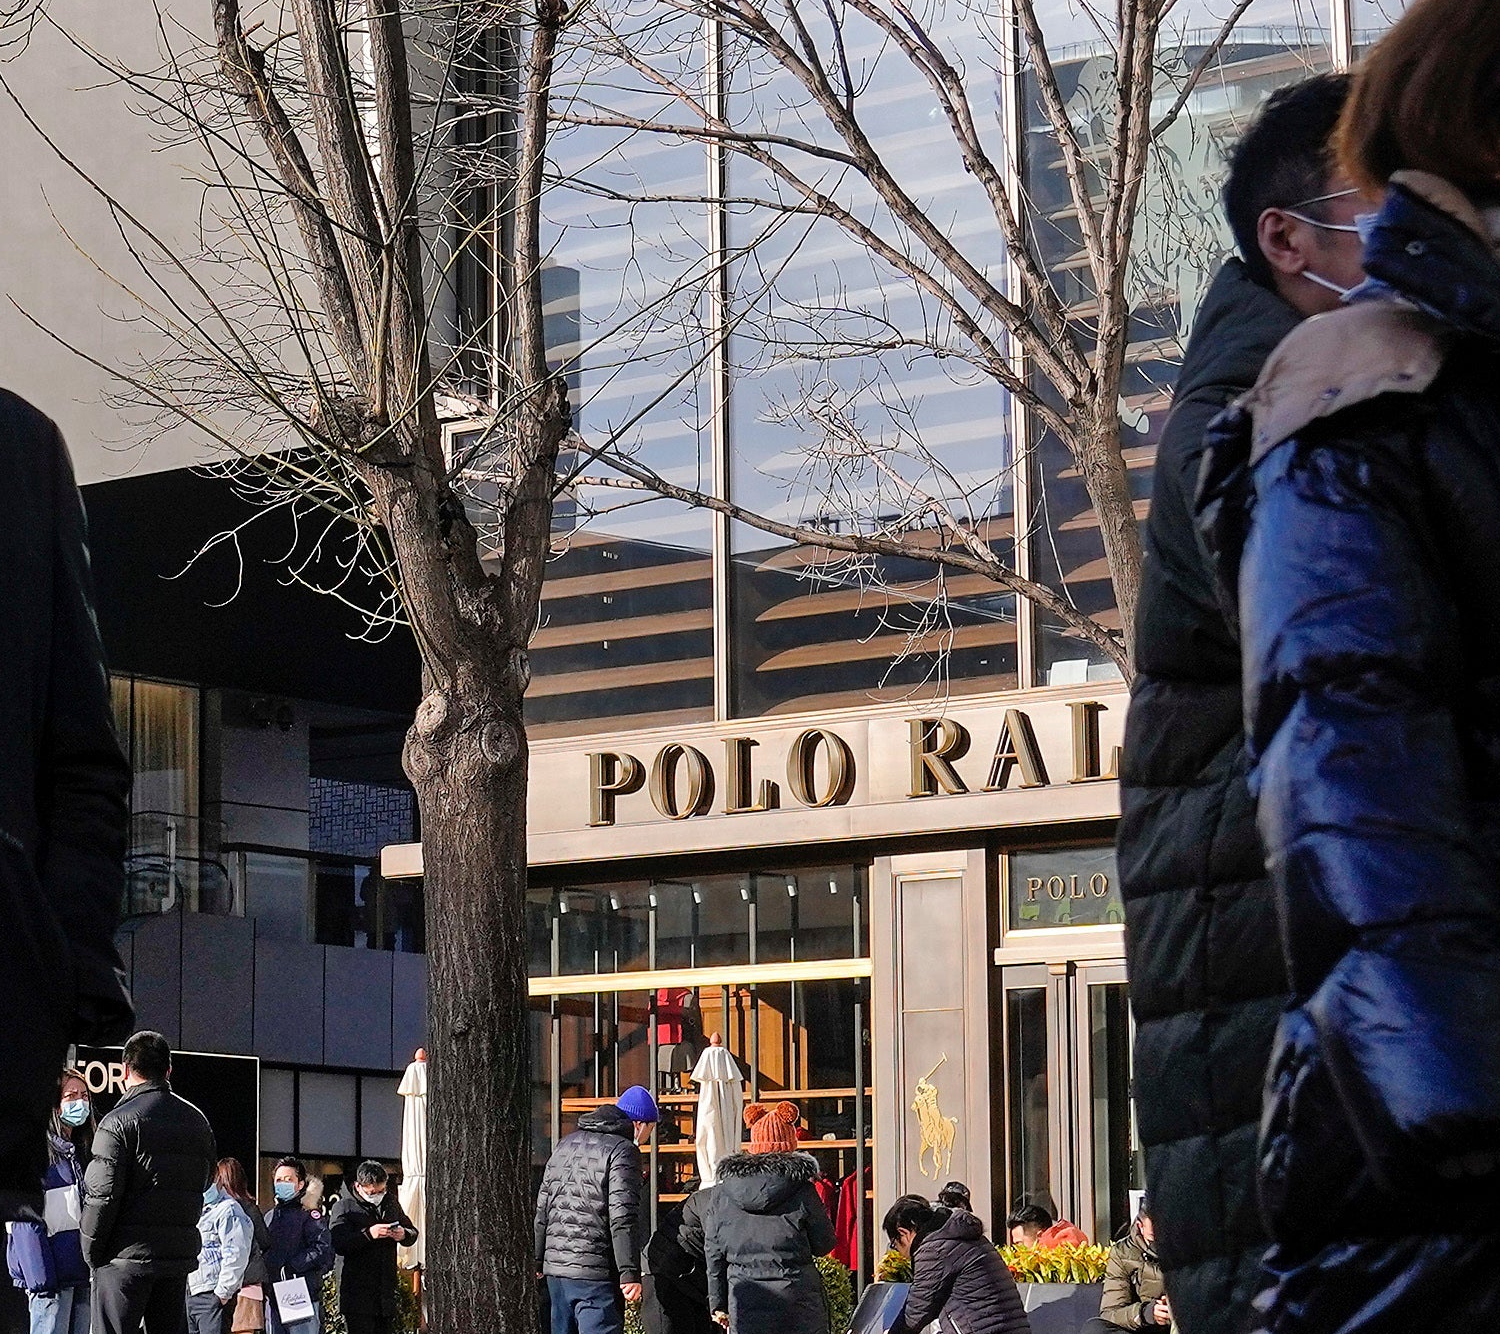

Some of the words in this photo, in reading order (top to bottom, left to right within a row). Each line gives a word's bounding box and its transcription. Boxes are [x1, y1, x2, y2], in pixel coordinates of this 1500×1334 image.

[584, 727, 858, 827] POLO
[905, 700, 1121, 799] RAL
[1026, 872, 1109, 902] POLO
[77, 1060, 126, 1094] OR
